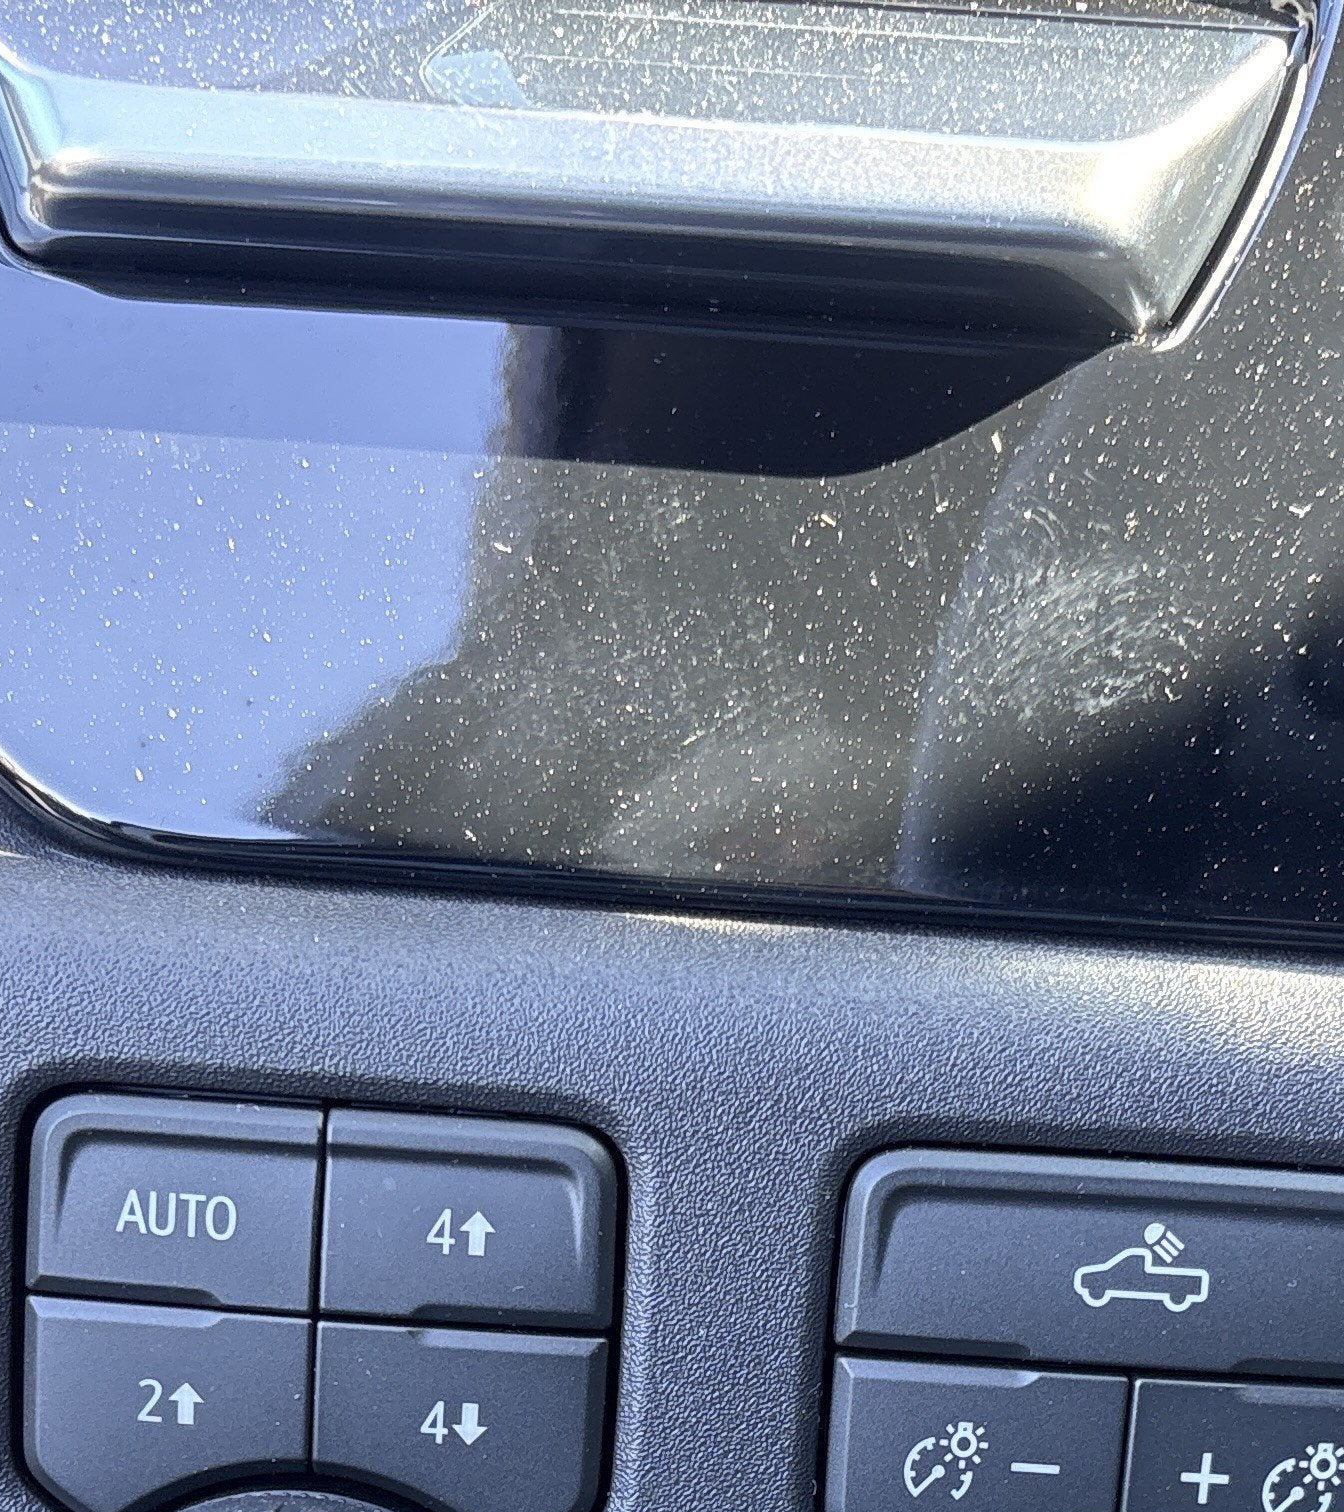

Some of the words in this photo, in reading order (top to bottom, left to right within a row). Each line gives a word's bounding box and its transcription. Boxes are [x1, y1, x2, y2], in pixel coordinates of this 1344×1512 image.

[115, 1188, 237, 1241] AUTO
[426, 1208, 456, 1255] 4
[137, 1378, 163, 1424] 2
[420, 1400, 449, 1445] 4
